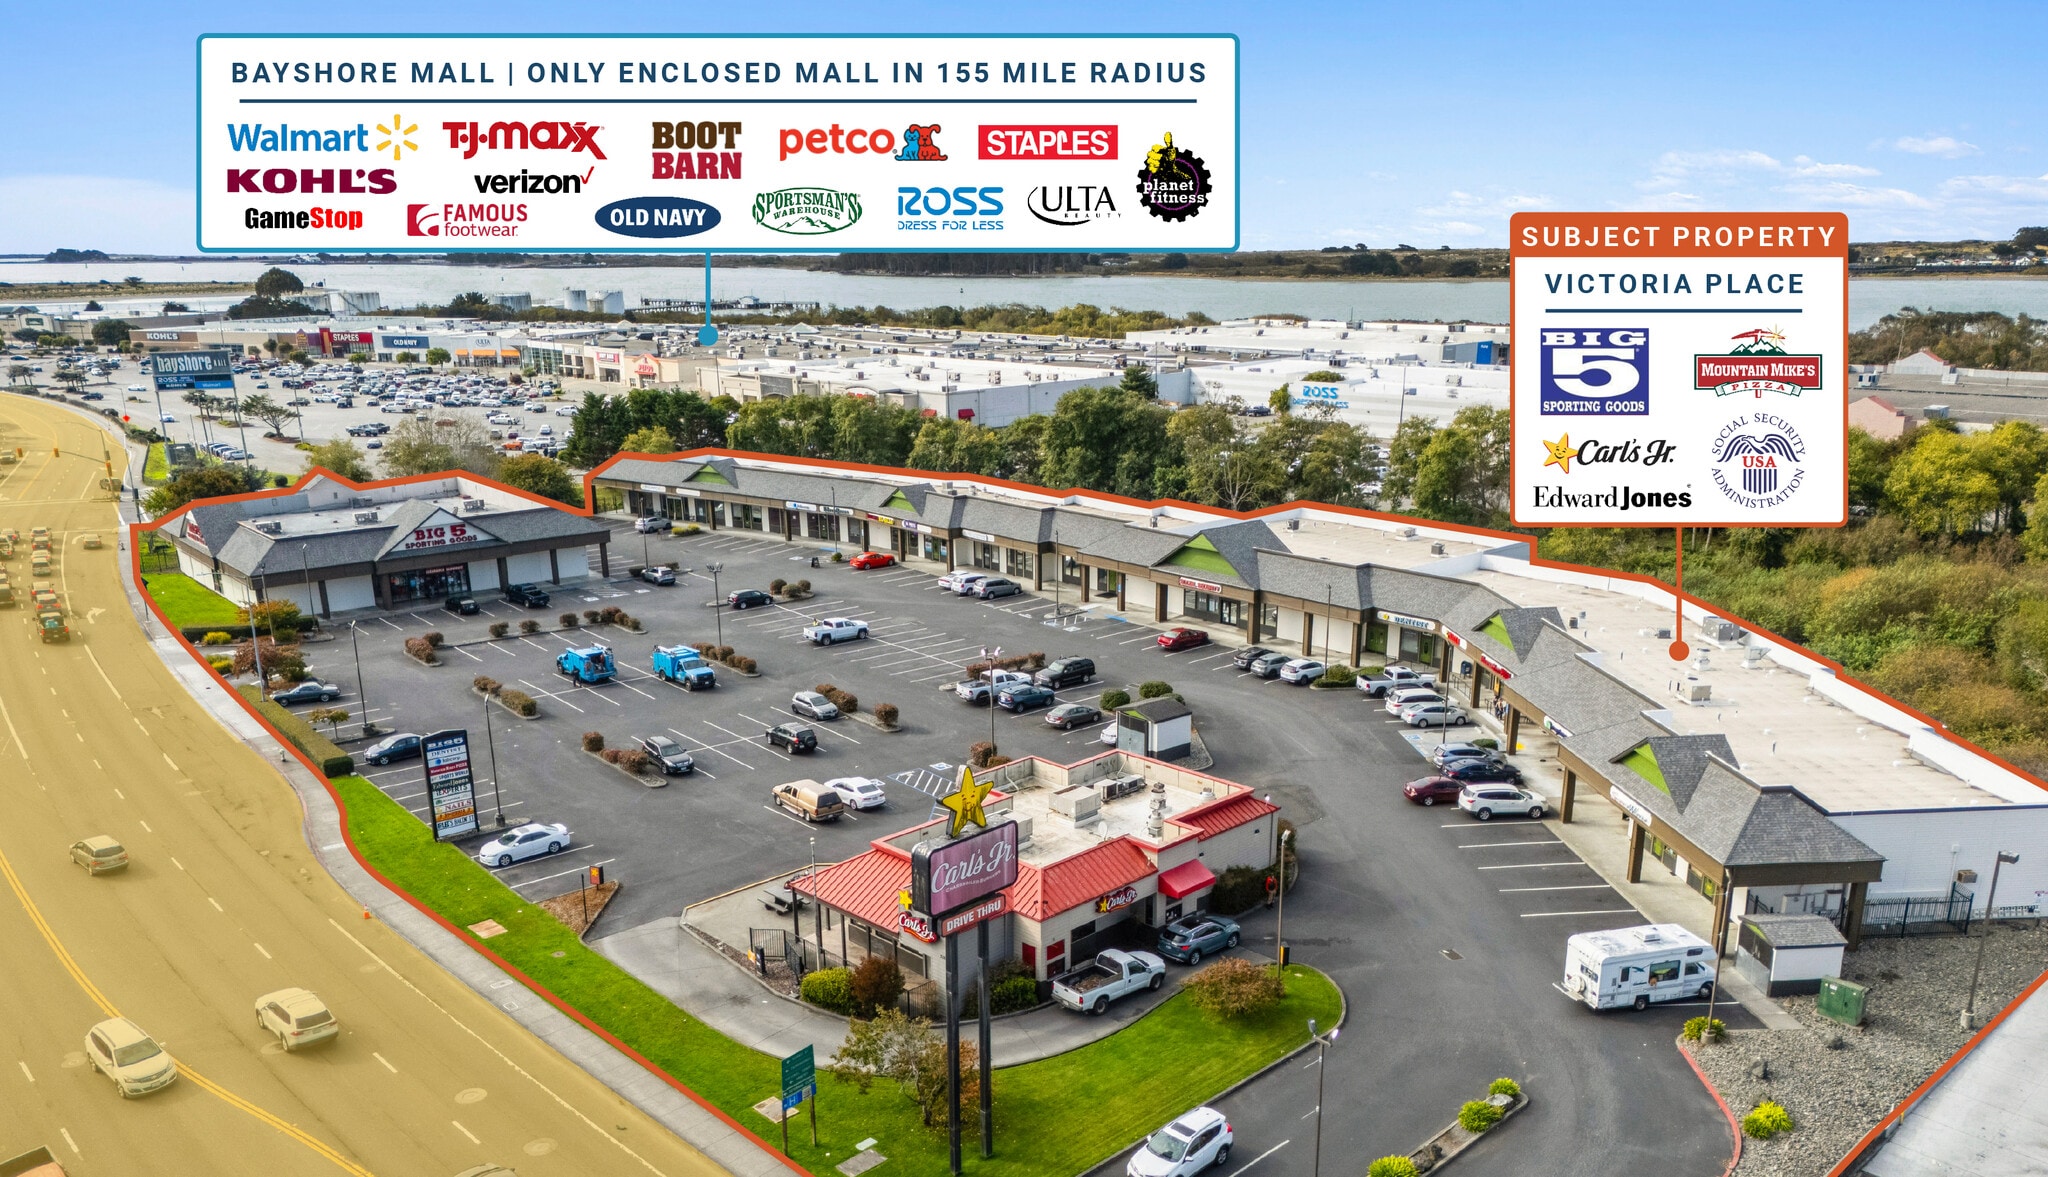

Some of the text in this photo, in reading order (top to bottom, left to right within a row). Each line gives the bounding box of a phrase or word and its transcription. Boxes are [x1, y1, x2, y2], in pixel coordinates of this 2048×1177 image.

[146, 332, 179, 341] KOHL'S
[332, 333, 360, 342] STAPLES
[156, 355, 213, 373] bayshore
[1302, 385, 1339, 399] ROSS
[414, 523, 467, 541] BIG 5
[405, 534, 477, 549] SPORTING GOODS
[931, 840, 1016, 893] Carl's Jr.
[946, 899, 1001, 932] DRIVE THRU
